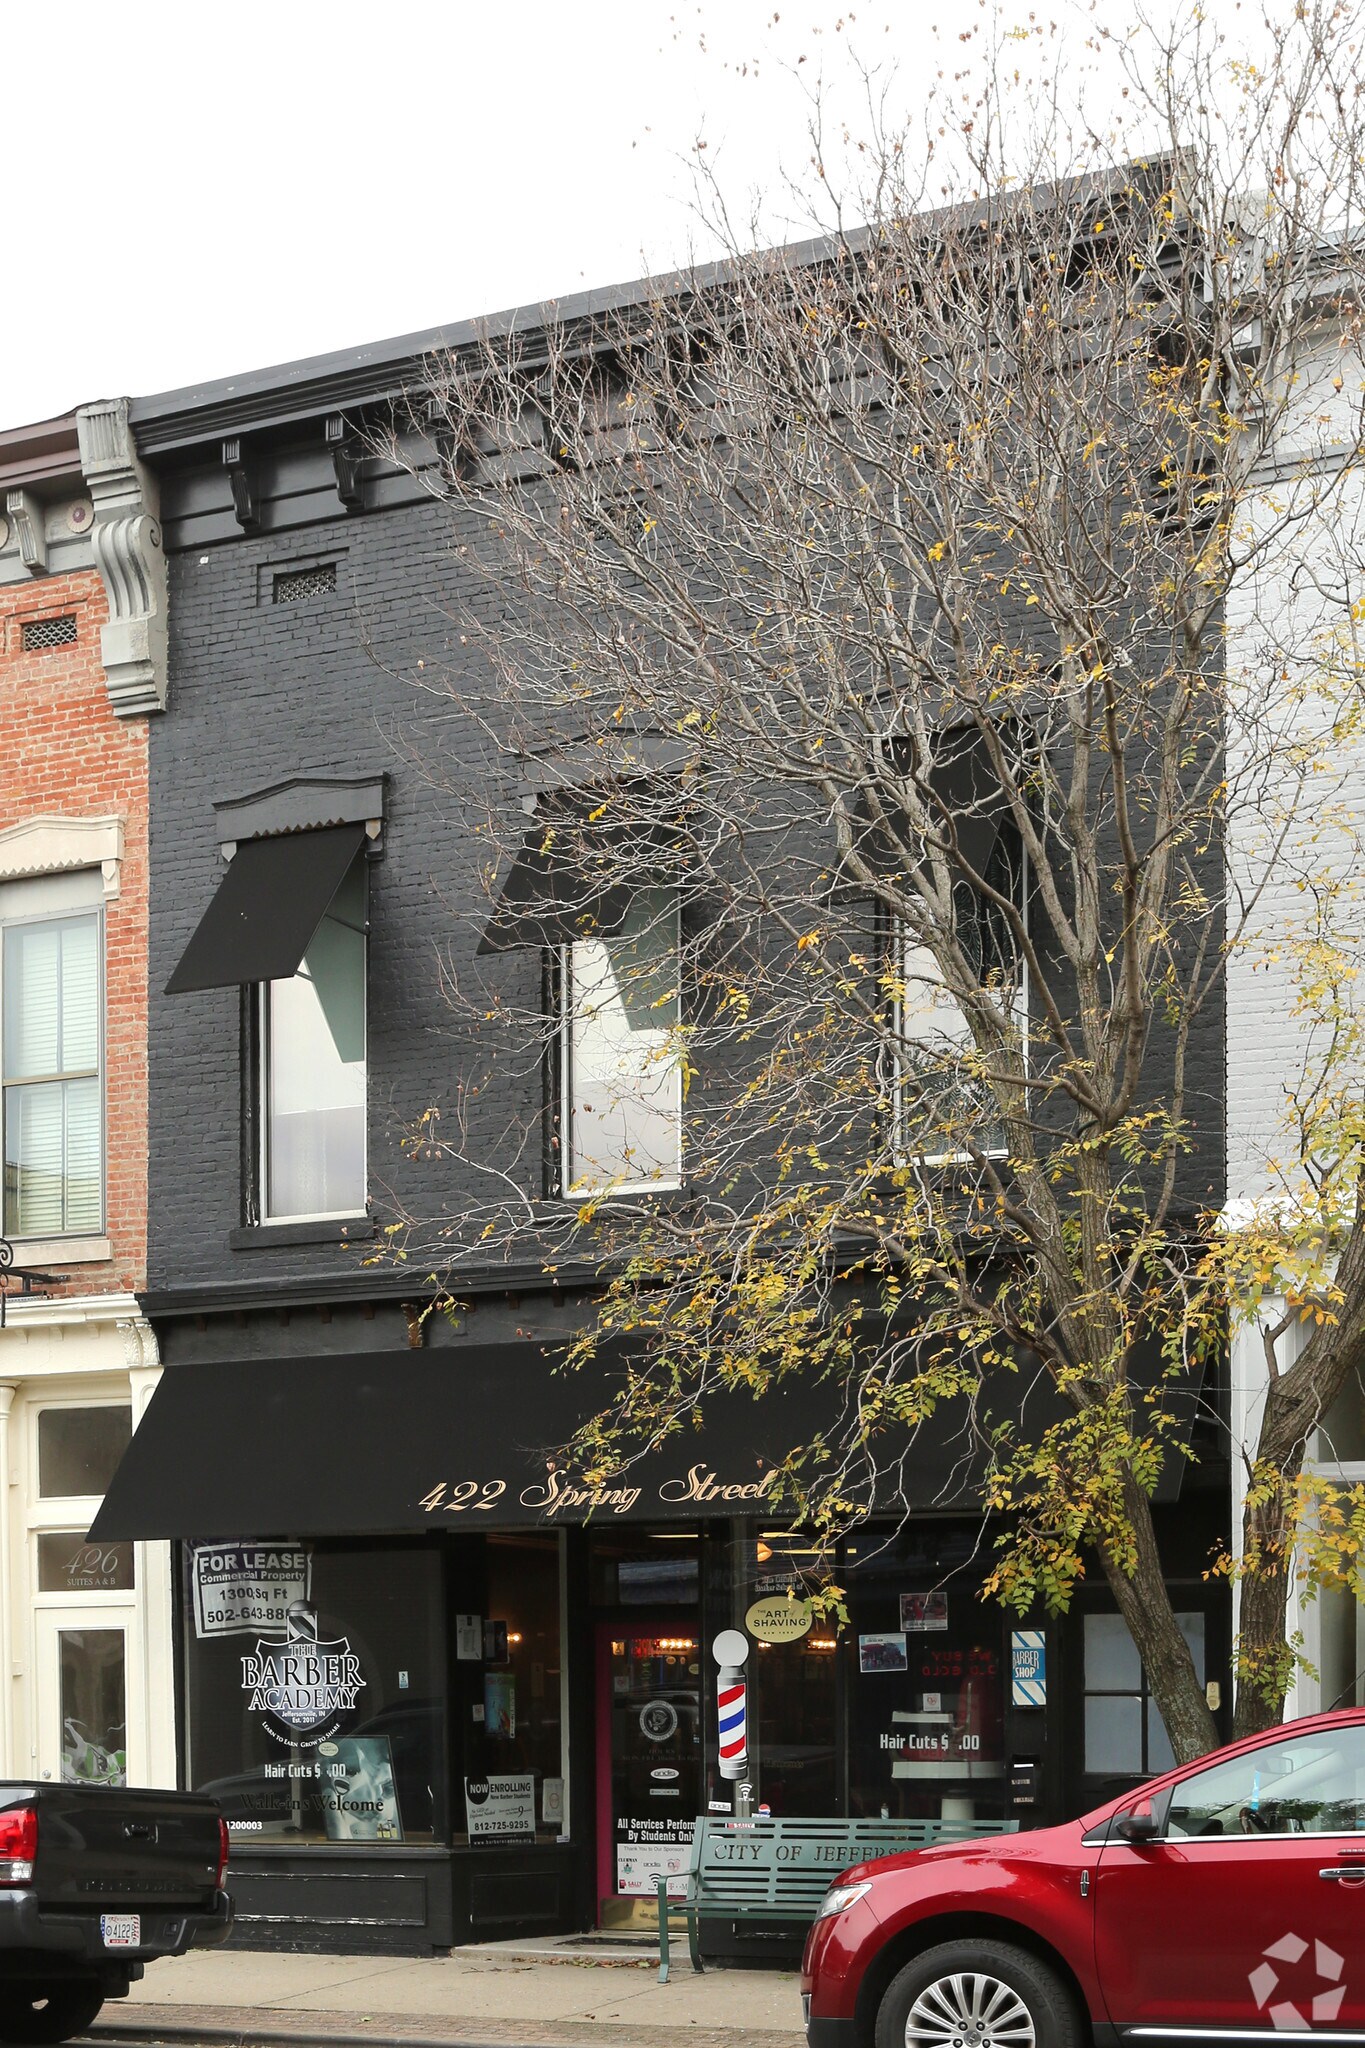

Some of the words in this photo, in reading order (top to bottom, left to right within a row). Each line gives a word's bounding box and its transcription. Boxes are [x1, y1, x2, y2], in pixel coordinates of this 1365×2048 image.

[418, 1479, 507, 1512] 422
[519, 1469, 642, 1516] Spring
[658, 1463, 779, 1502] Street
[61, 1545, 120, 1574] 426
[200, 1554, 239, 1573] FOR
[242, 1552, 305, 1570] LEASE
[66, 1578, 93, 1586] SUITES
[110, 1577, 116, 1585] B
[200, 1570, 258, 1584] Commercial
[260, 1570, 305, 1582] Property
[219, 1587, 253, 1600] 1300
[255, 1588, 269, 1601] Sq
[273, 1588, 287, 1599] Ft
[207, 1607, 288, 1623] 502-643-88
[765, 1610, 788, 1618] ART
[753, 1618, 807, 1627] SHAVING
[288, 1644, 317, 1656] THE
[240, 1655, 367, 1688] BARBER
[1015, 1667, 1036, 1678] SHOP
[248, 1687, 360, 1711] ACADEMY
[281, 1710, 318, 1718] Jeffersonville,
[880, 1733, 906, 1749] Hair
[909, 1734, 938, 1750] Cuts
[941, 1733, 949, 1751] $
[958, 1734, 980, 1750] .00
[264, 1763, 286, 1778] Hair
[288, 1764, 312, 1778] Cuts
[314, 1763, 321, 1779] $
[469, 1783, 489, 1794] NOW
[490, 1782, 531, 1793] ENROLLING
[310, 1794, 384, 1812] Welcome
[517, 1805, 524, 1818] 9
[474, 1820, 529, 1831] 812-725-9295
[617, 1818, 629, 1829] All
[631, 1818, 664, 1829] Services
[667, 1819, 696, 1830] Perform
[628, 1830, 639, 1843] By
[641, 1830, 676, 1842] Students
[714, 1845, 763, 1860] CITY
[775, 1845, 802, 1861] OF
[113, 1923, 130, 1938] 4122
